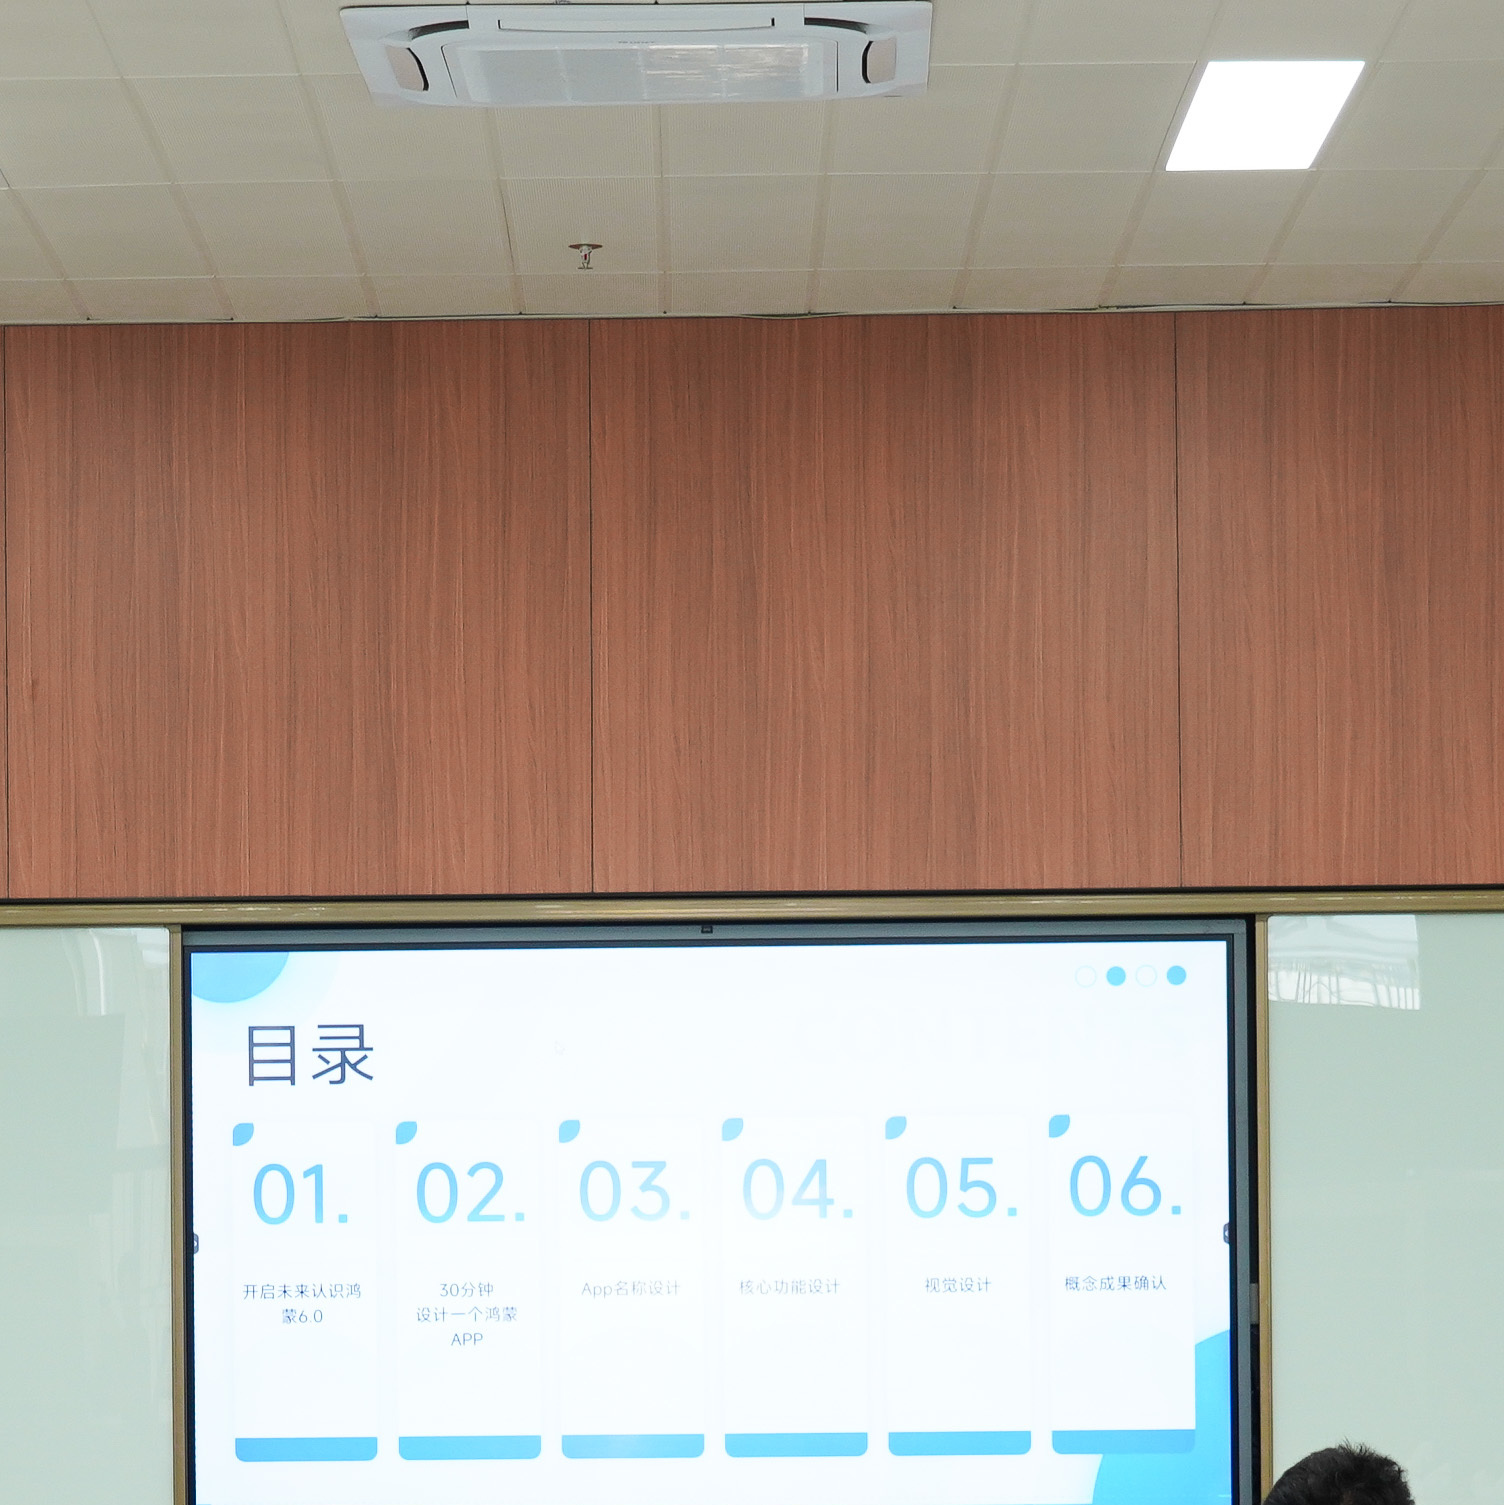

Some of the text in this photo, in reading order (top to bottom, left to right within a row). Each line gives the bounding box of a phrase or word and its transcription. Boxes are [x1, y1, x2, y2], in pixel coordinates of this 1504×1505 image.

[248, 1023, 374, 1087] 目录
[252, 1162, 349, 1226] 01.
[415, 1160, 526, 1225] 02.
[578, 1159, 691, 1223] 03.
[742, 1158, 854, 1221] 04.
[905, 1156, 1018, 1220] 05.
[1068, 1154, 1183, 1218] 06.
[242, 1282, 362, 1301] 开启未来认识鸿
[439, 1281, 494, 1298] 30分钟
[580, 1279, 681, 1300] App名称设计
[739, 1278, 841, 1296] 核心功能设计
[924, 1276, 993, 1294] 视觉设计
[1064, 1274, 1168, 1293] 概念成果确认
[281, 1307, 324, 1325] 蒙6.0
[416, 1305, 518, 1324] 设计一个鸿蒙
[450, 1332, 484, 1347] APP
